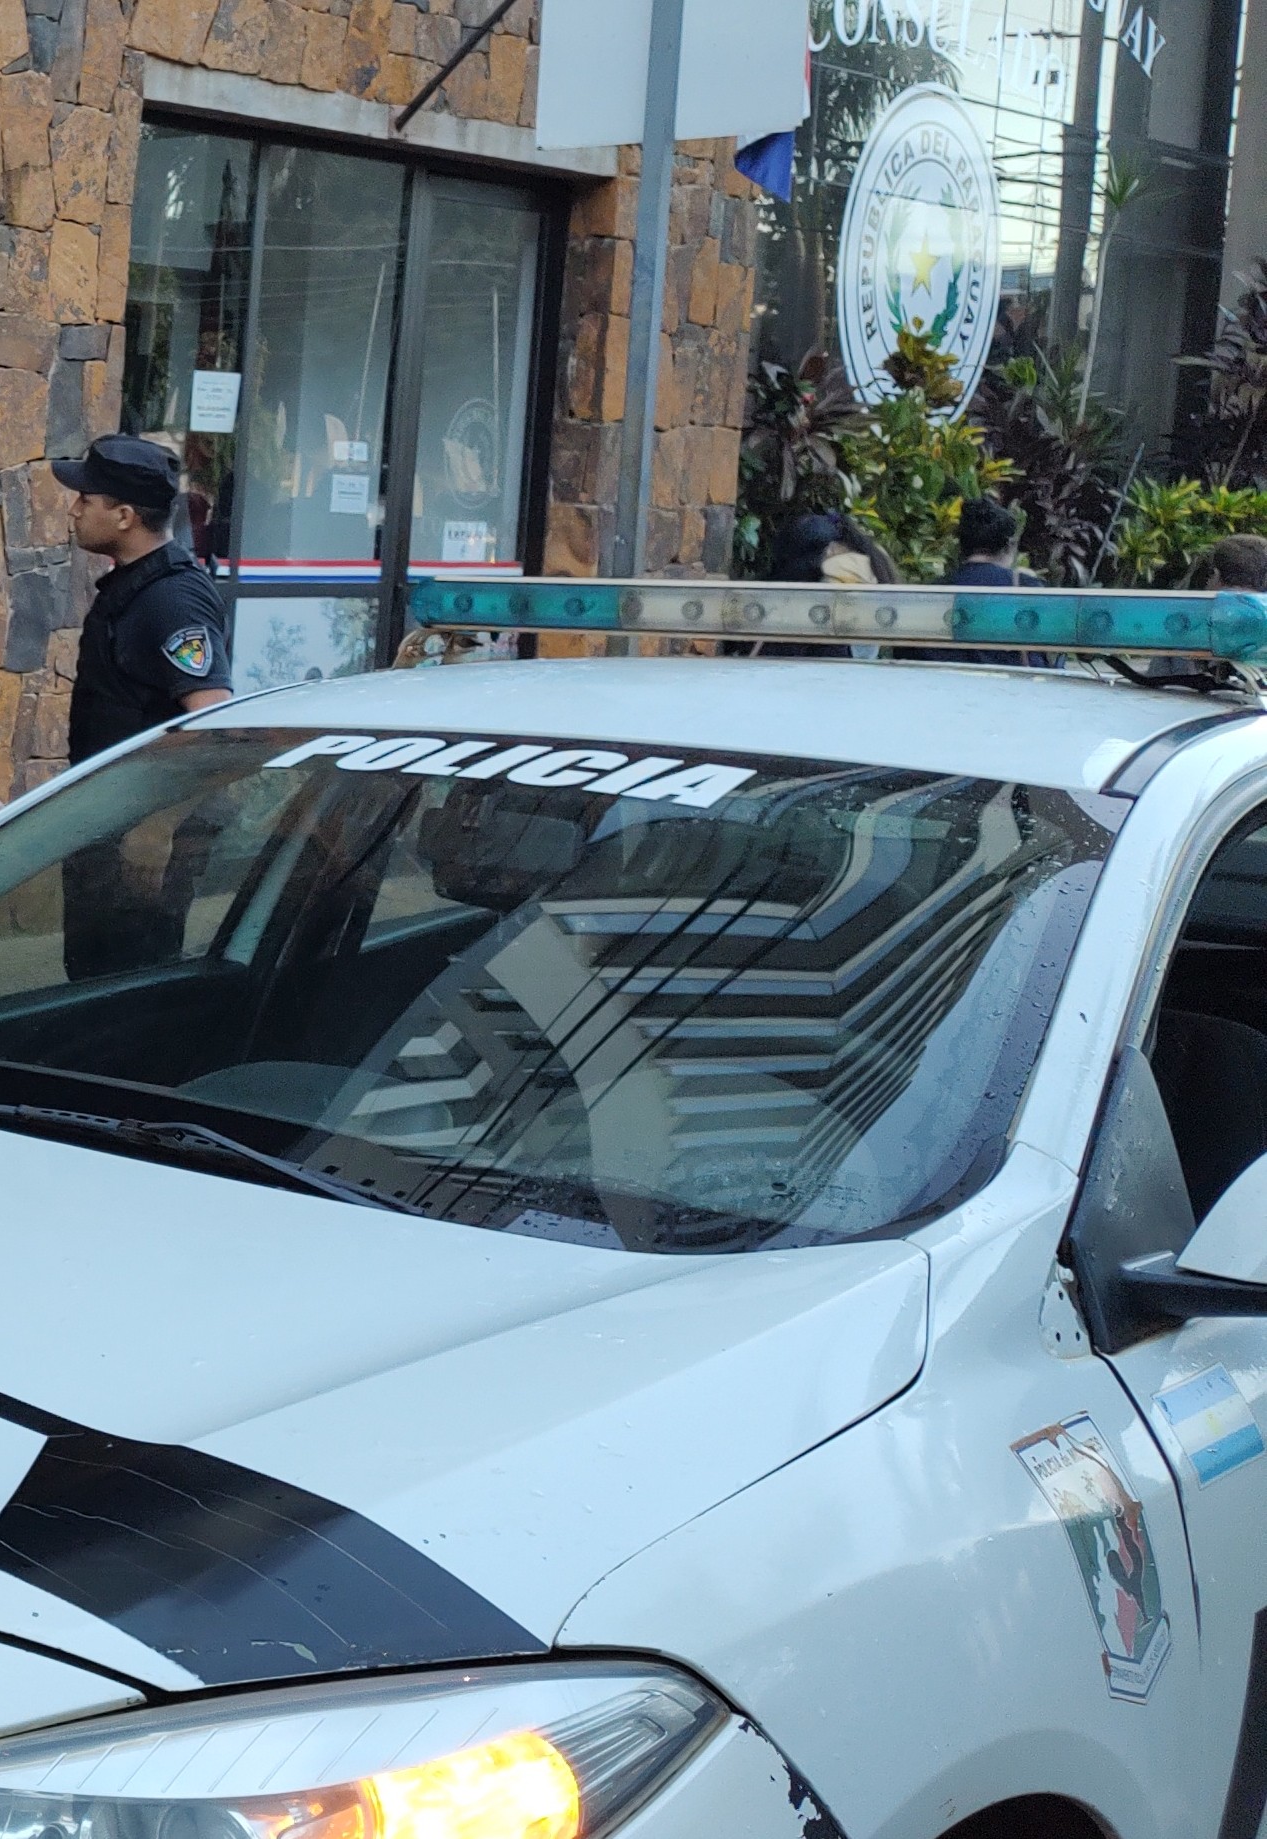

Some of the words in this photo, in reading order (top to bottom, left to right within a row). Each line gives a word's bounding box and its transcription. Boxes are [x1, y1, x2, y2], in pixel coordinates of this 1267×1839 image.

[806, 0, 1065, 117] ONSULADO
[921, 129, 951, 164] DEL
[262, 735, 758, 809] POLICIA
